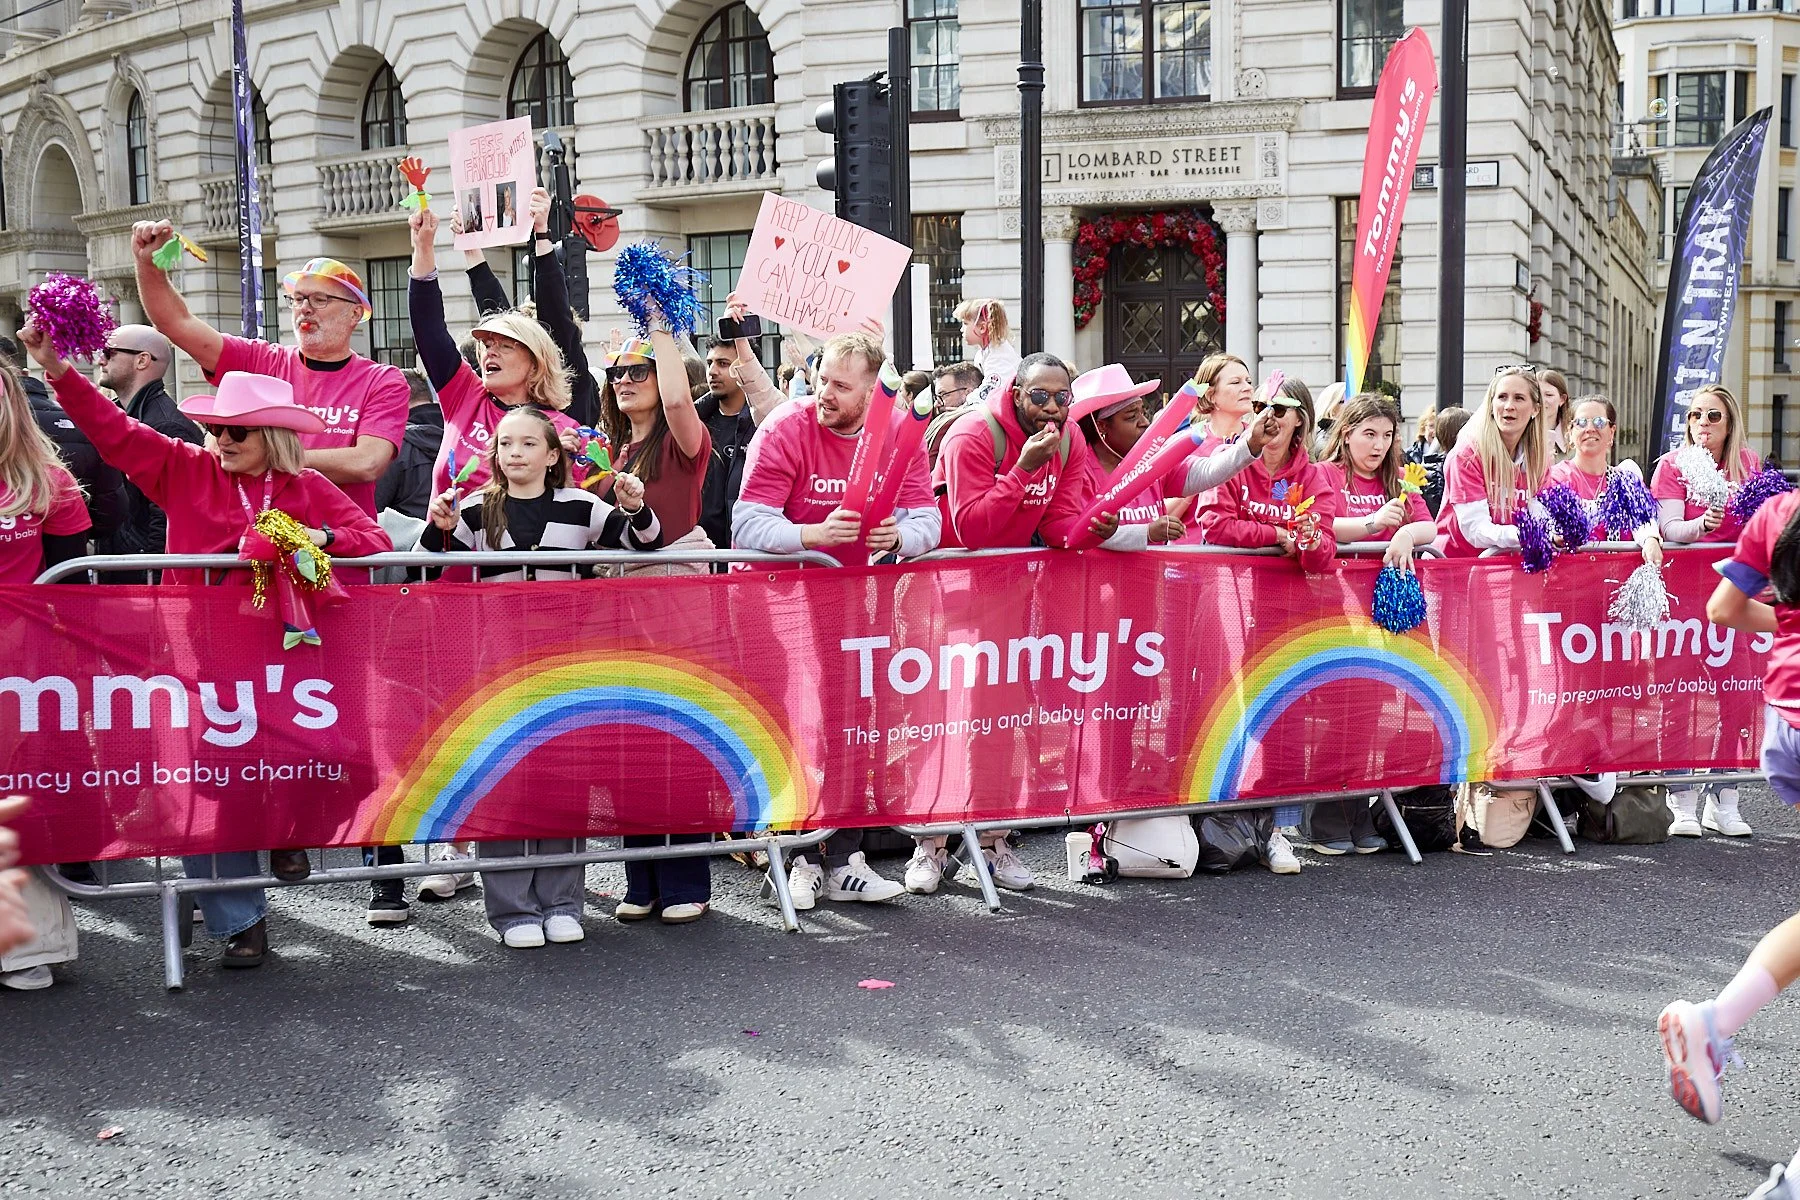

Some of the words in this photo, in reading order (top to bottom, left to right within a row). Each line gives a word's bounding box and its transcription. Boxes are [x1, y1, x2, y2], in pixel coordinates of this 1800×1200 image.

[470, 133, 503, 159] JESS
[1068, 150, 1162, 168] LOMBARD
[1172, 146, 1242, 164] STREET
[1068, 170, 1135, 181] RESTAURANT
[1150, 168, 1169, 177] BAR
[1184, 165, 1241, 176] BRASSERIE
[1363, 76, 1417, 258] Tommy's
[1376, 249, 1385, 274] The
[1382, 192, 1400, 249] pregnancy
[1398, 168, 1406, 192] and
[1403, 134, 1414, 166] baby
[1410, 91, 1425, 133] charity
[770, 197, 809, 233] KEEP
[814, 213, 875, 259] GOING
[757, 258, 796, 293] CAN
[791, 237, 833, 280] YOU
[761, 288, 837, 333] #LLHM26
[1712, 263, 1736, 364] ANYWHERE
[1104, 461, 1153, 501] Tommy's
[1340, 488, 1386, 506] Tomm
[15, 527, 37, 540] baby
[840, 618, 1166, 698] Tommy's
[0, 664, 339, 748] mmy's
[1528, 689, 1557, 705] The
[1561, 684, 1642, 704] pregnancy
[1647, 679, 1676, 696] and
[1677, 678, 1717, 696] baby
[1722, 675, 1764, 692] charit
[843, 727, 881, 745] The
[887, 716, 992, 741] pregnancy
[998, 708, 1034, 729] and
[1038, 704, 1085, 725] baby
[1091, 701, 1163, 722] charity
[0, 772, 72, 794] ancy
[82, 761, 141, 787] and
[153, 758, 230, 787] baby
[241, 758, 343, 782] charity
